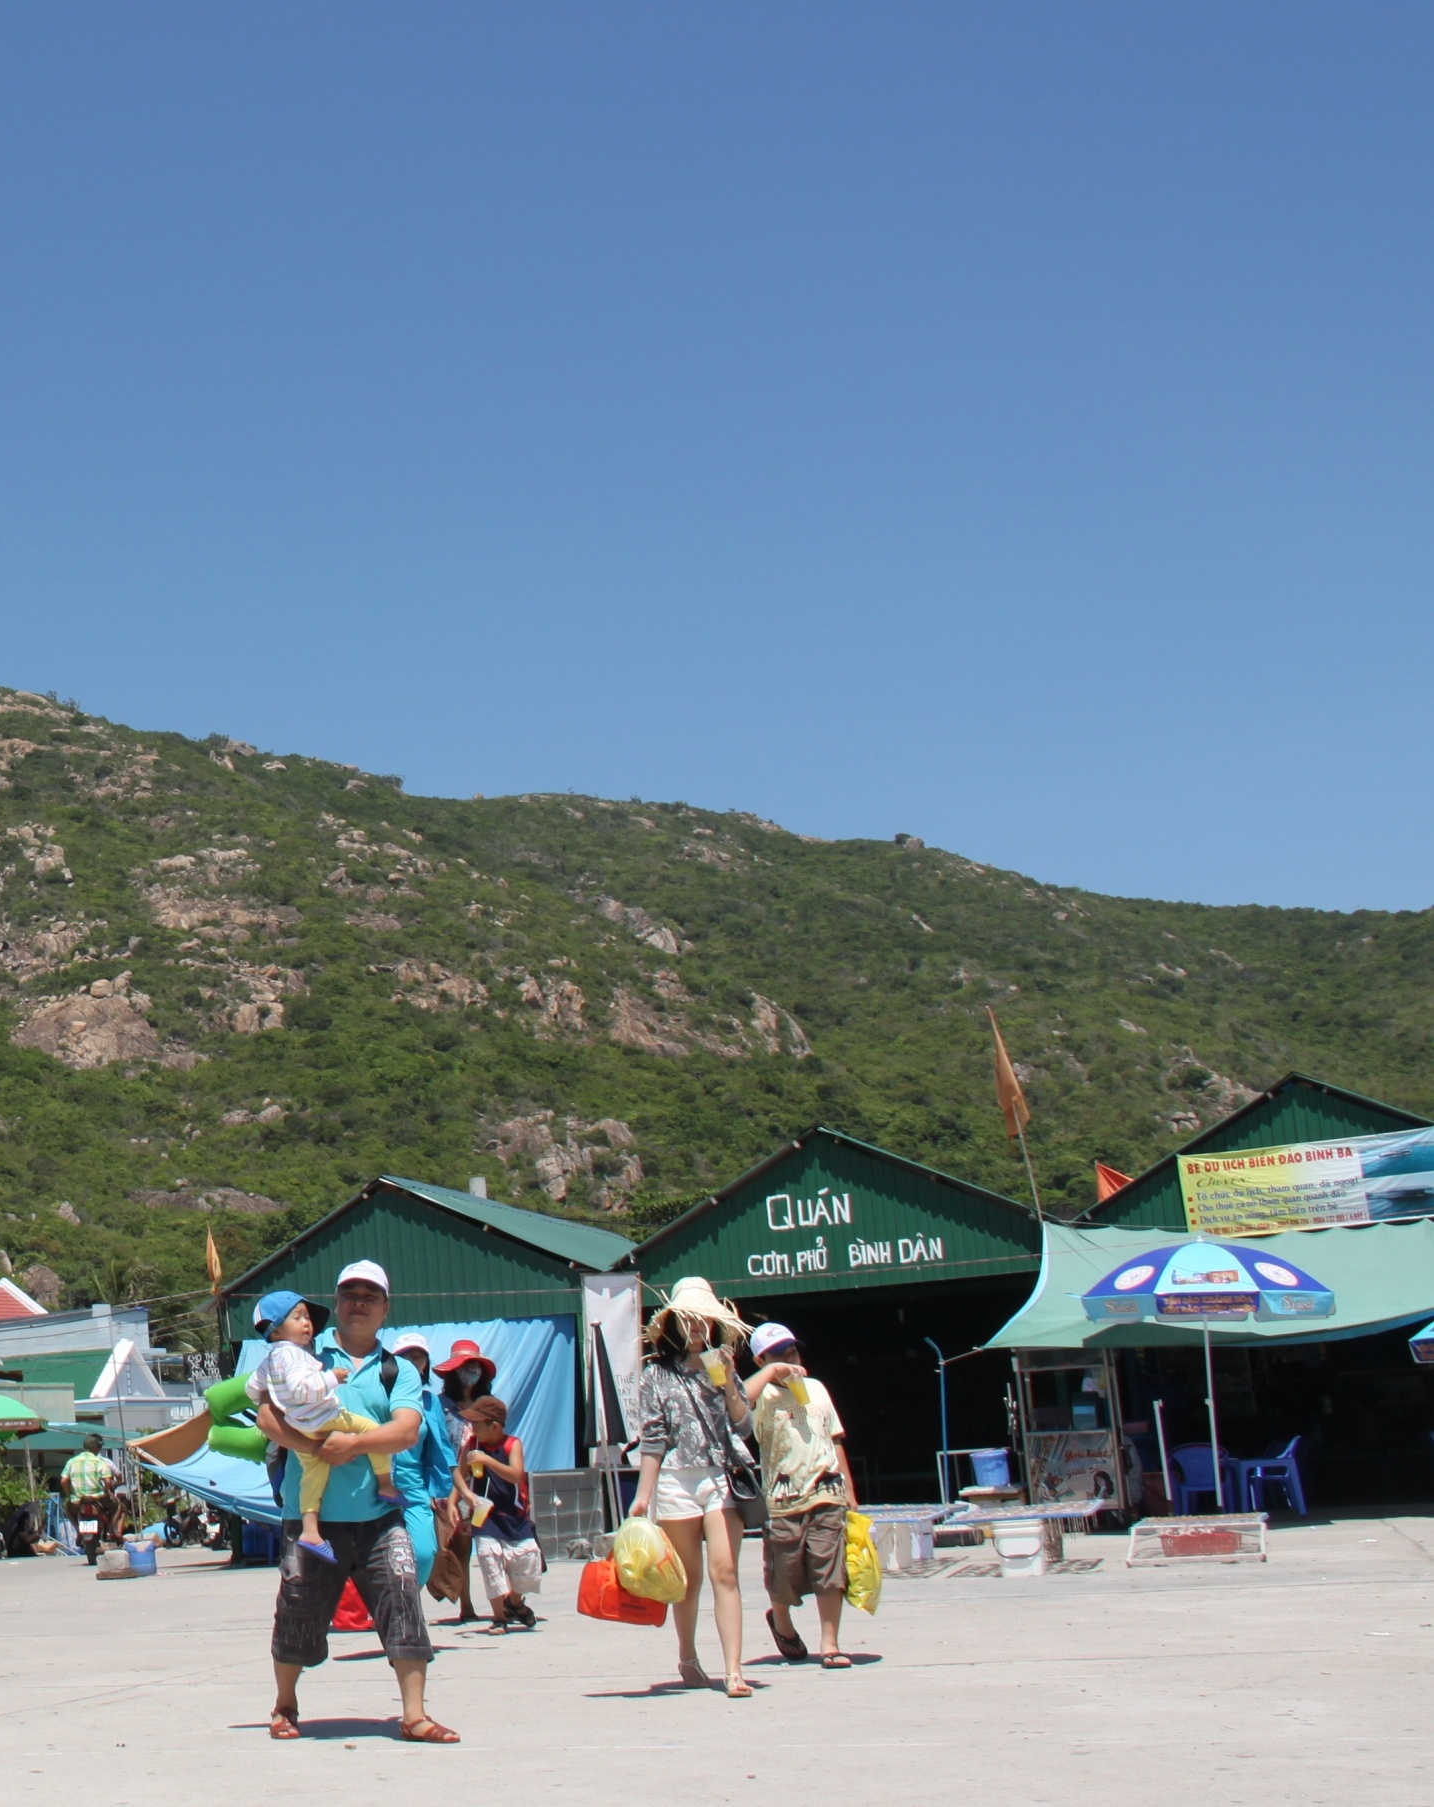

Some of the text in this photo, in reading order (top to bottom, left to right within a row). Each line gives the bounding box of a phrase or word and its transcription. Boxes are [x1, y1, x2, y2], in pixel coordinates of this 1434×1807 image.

[1204, 1161, 1220, 1173] DU
[1248, 1150, 1275, 1168] BIỂN
[1337, 1147, 1353, 1158] BA
[1267, 1184, 1290, 1194] tham
[766, 1187, 852, 1232] QUÁN
[1197, 1203, 1214, 1213] Cho
[848, 1237, 893, 1269] BÌNH
[897, 1232, 944, 1265] DÂN
